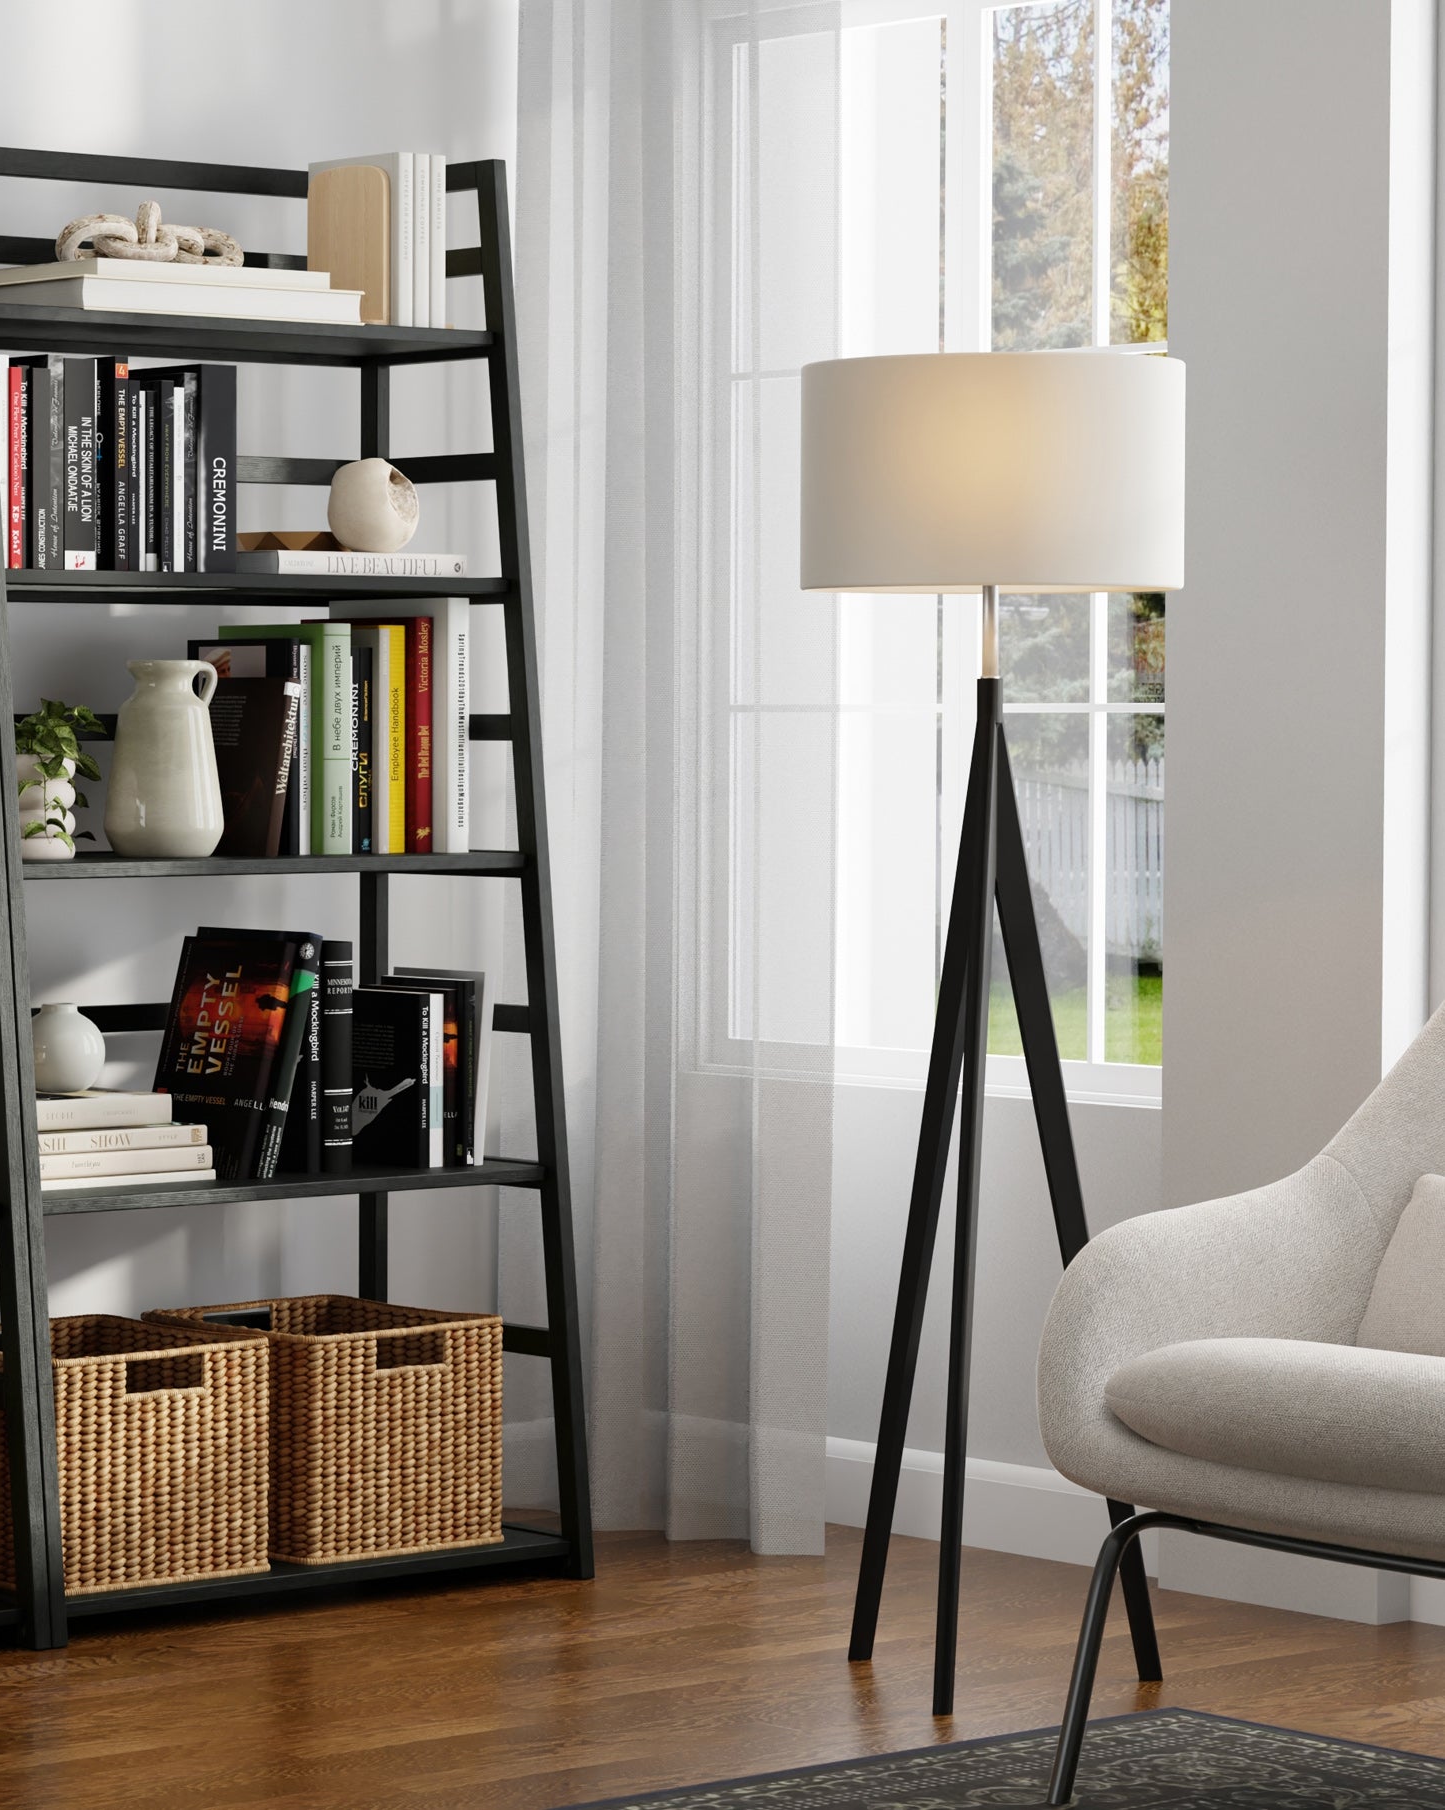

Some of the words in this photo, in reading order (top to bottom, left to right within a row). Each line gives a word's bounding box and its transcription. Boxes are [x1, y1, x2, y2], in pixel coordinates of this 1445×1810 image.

[118, 366, 126, 377] 4
[118, 389, 126, 406] THE
[81, 417, 92, 427] IN
[118, 408, 126, 436] EMPTY
[68, 426, 78, 464] MICHAEL
[81, 429, 92, 448] THE
[118, 438, 126, 468] VESSEL
[81, 450, 92, 473] SKIN
[68, 467, 78, 511] ONDAATJE
[81, 475, 92, 488] OF
[81, 499, 92, 522] LION
[118, 481, 126, 525] ANGELLA
[213, 457, 226, 551] CREMONINI
[38, 509, 47, 551] CONSTRUCTION
[118, 529, 126, 560] GRAFF
[327, 556, 359, 575] LIVE
[363, 557, 442, 577] BEAUTIFUL
[418, 622, 431, 655] Mosley
[331, 645, 343, 689] империй
[418, 657, 429, 693] Victoria
[332, 691, 344, 714] двух
[391, 688, 400, 733] Handbook
[332, 717, 342, 741] небе
[275, 695, 301, 796] Weltarchitektur
[391, 736, 401, 781] Employee
[359, 752, 368, 808] СЛУГИ
[418, 768, 429, 779] The
[187, 972, 221, 1076] EMPTY
[205, 964, 243, 1078] VESSEL
[421, 1006, 429, 1016] To
[421, 1018, 429, 1029] Kill
[309, 1000, 320, 1062] Mockingbird
[175, 1042, 191, 1073] THE
[421, 1038, 429, 1085] Mockingbird
[185, 1095, 205, 1104] EMPTY
[206, 1096, 226, 1105] VESSEL
[359, 1095, 378, 1109] kill
[90, 1133, 132, 1149] SHOW
